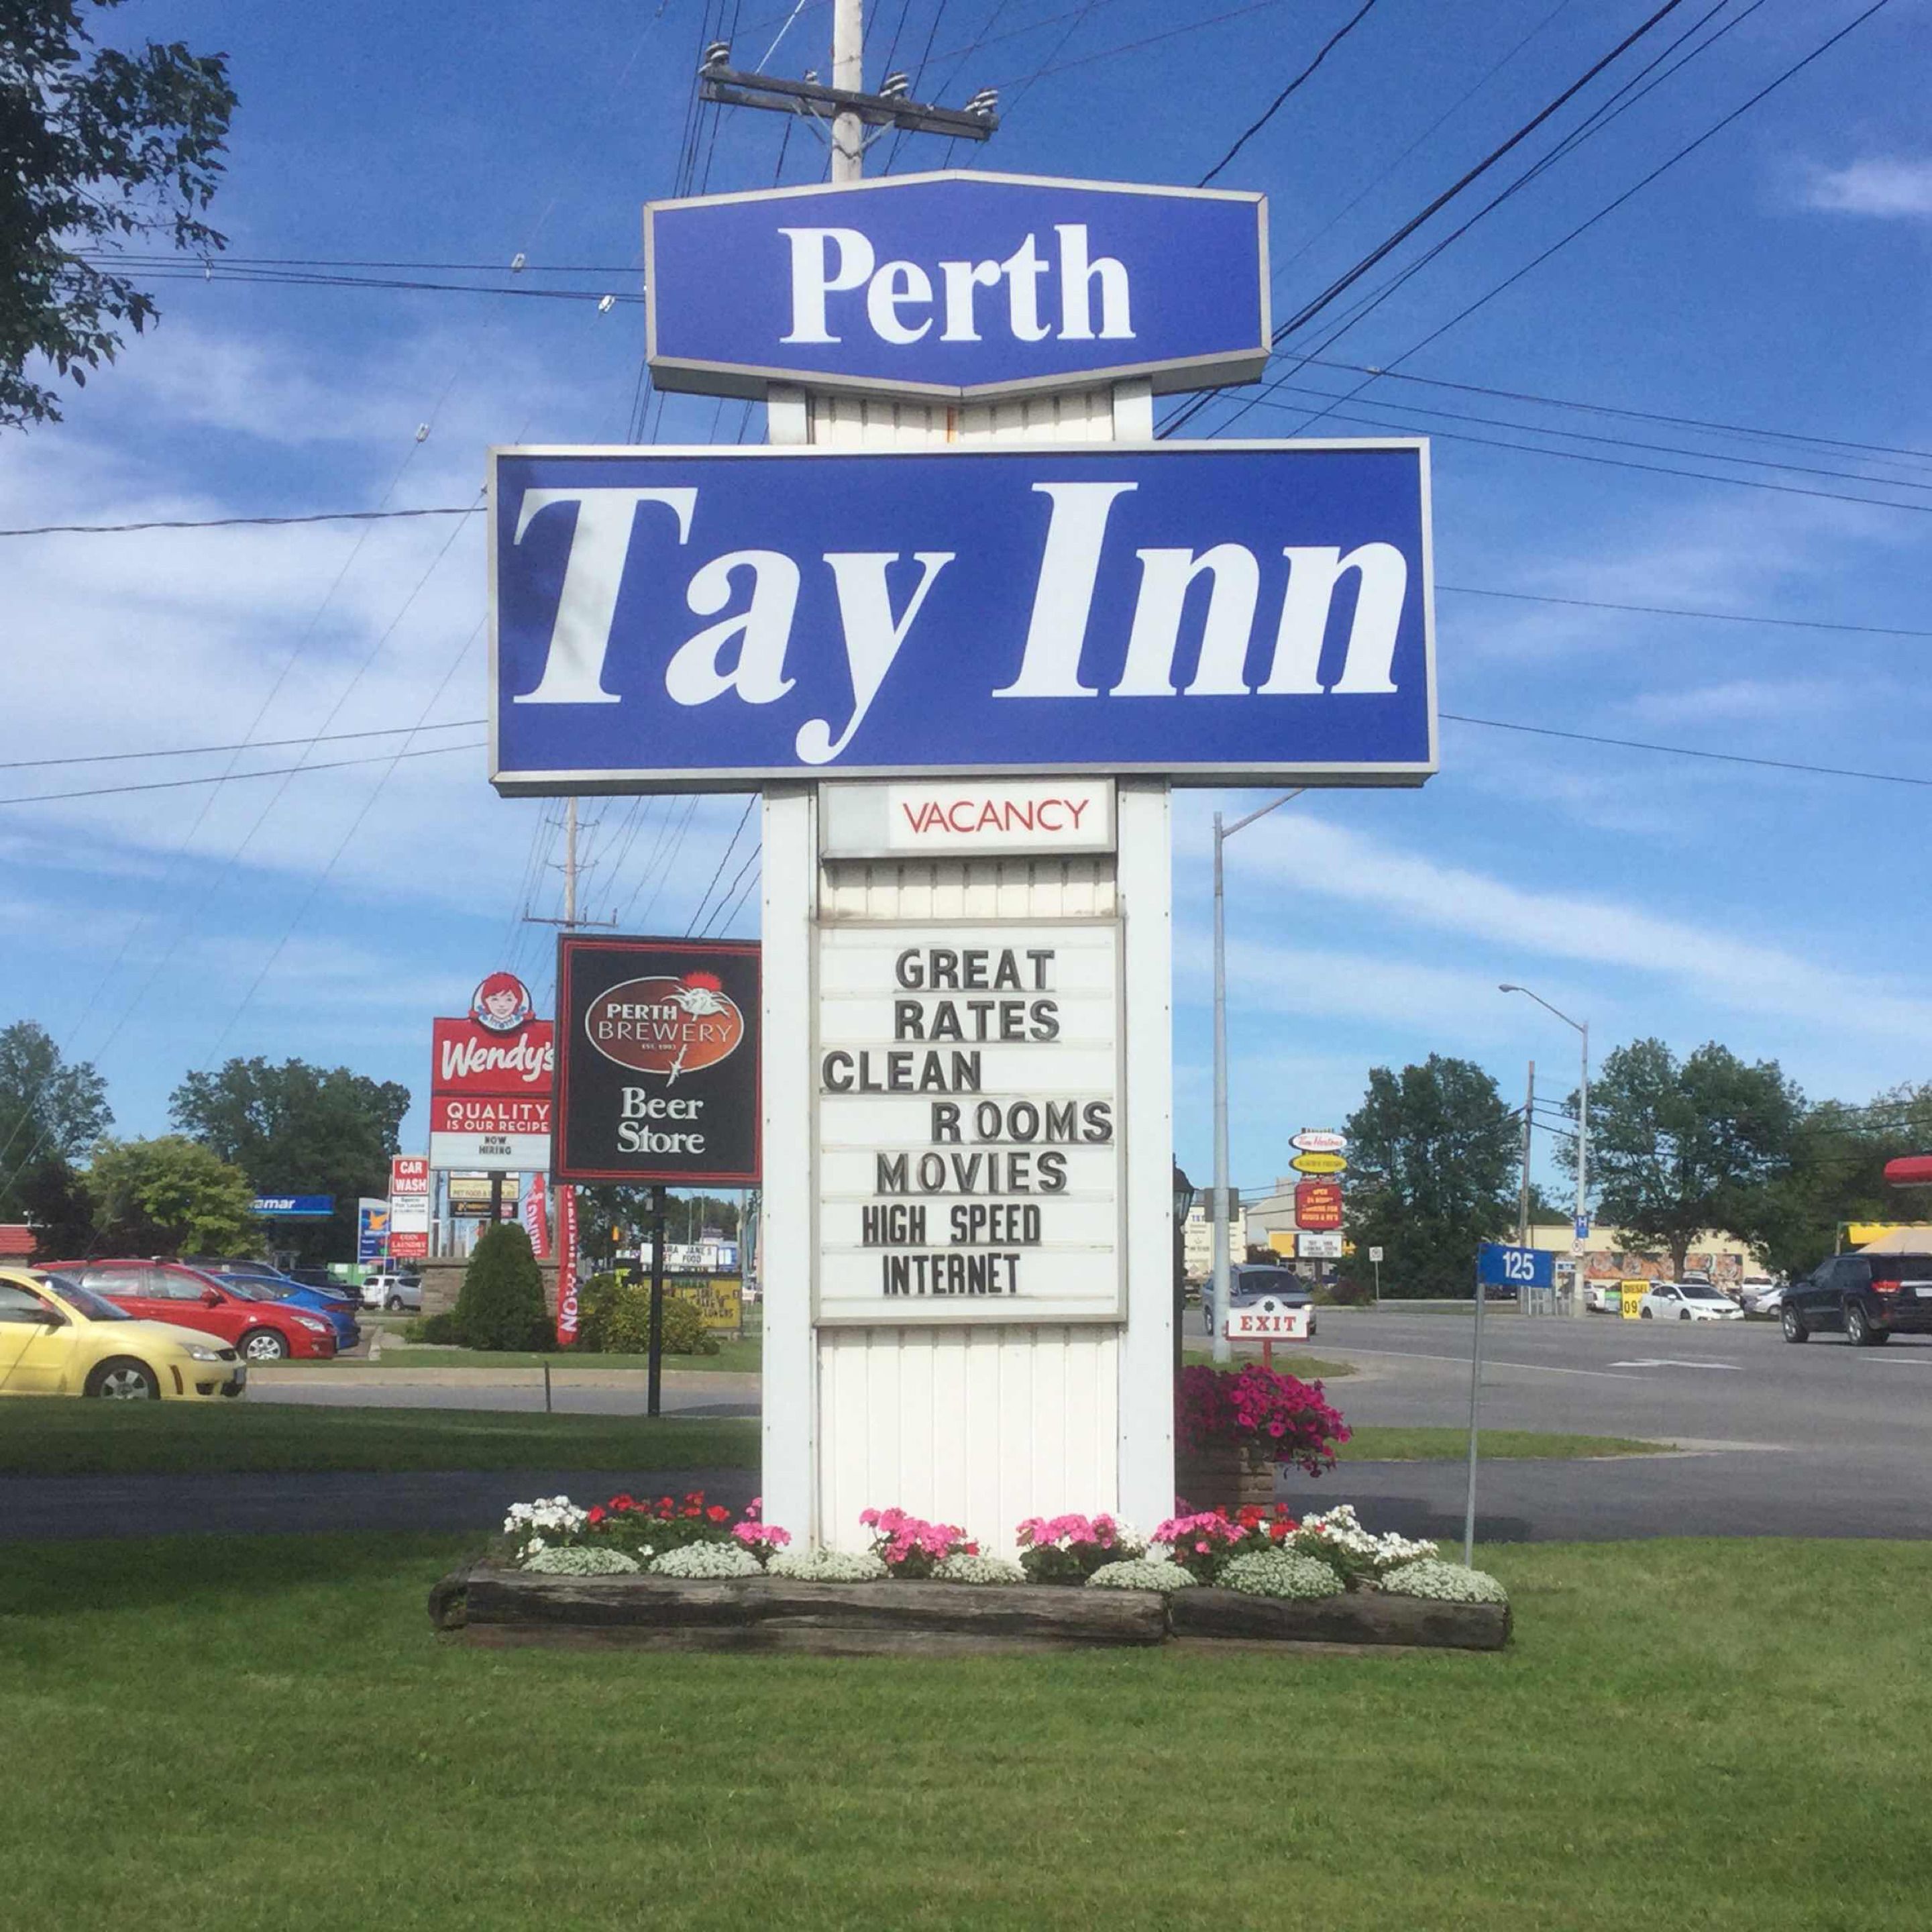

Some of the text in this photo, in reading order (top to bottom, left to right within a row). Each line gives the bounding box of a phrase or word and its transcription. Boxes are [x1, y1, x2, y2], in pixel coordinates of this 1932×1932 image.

[777, 224, 1136, 344] Perth
[513, 482, 1408, 765] Tay Inn
[902, 799, 1090, 835] VACANCY
[896, 948, 1055, 990] GREAT
[606, 1003, 678, 1021] PERTH
[894, 1000, 1061, 1042] RATES
[598, 1020, 733, 1042] BREWERY
[441, 1032, 555, 1083] Wendy's
[822, 1051, 981, 1092] CLEAN
[447, 1102, 550, 1120] QUALITY
[621, 1087, 704, 1120] Beer
[447, 1120, 551, 1132] IS OUR RECIPE
[617, 1121, 706, 1154] Store
[931, 1101, 1113, 1142] ROOMS
[479, 1145, 512, 1155] HIRING
[484, 1136, 507, 1144] NOW
[400, 1161, 423, 1174] CAR
[876, 1151, 1068, 1193] MOVIES
[395, 1178, 427, 1191] WASH
[862, 1204, 1042, 1244] HIGH SPEED
[1578, 1217, 1587, 1226] H
[883, 1252, 1020, 1295] INTERNET
[1503, 1250, 1534, 1281] 125
[1240, 1316, 1297, 1332] EXIT
